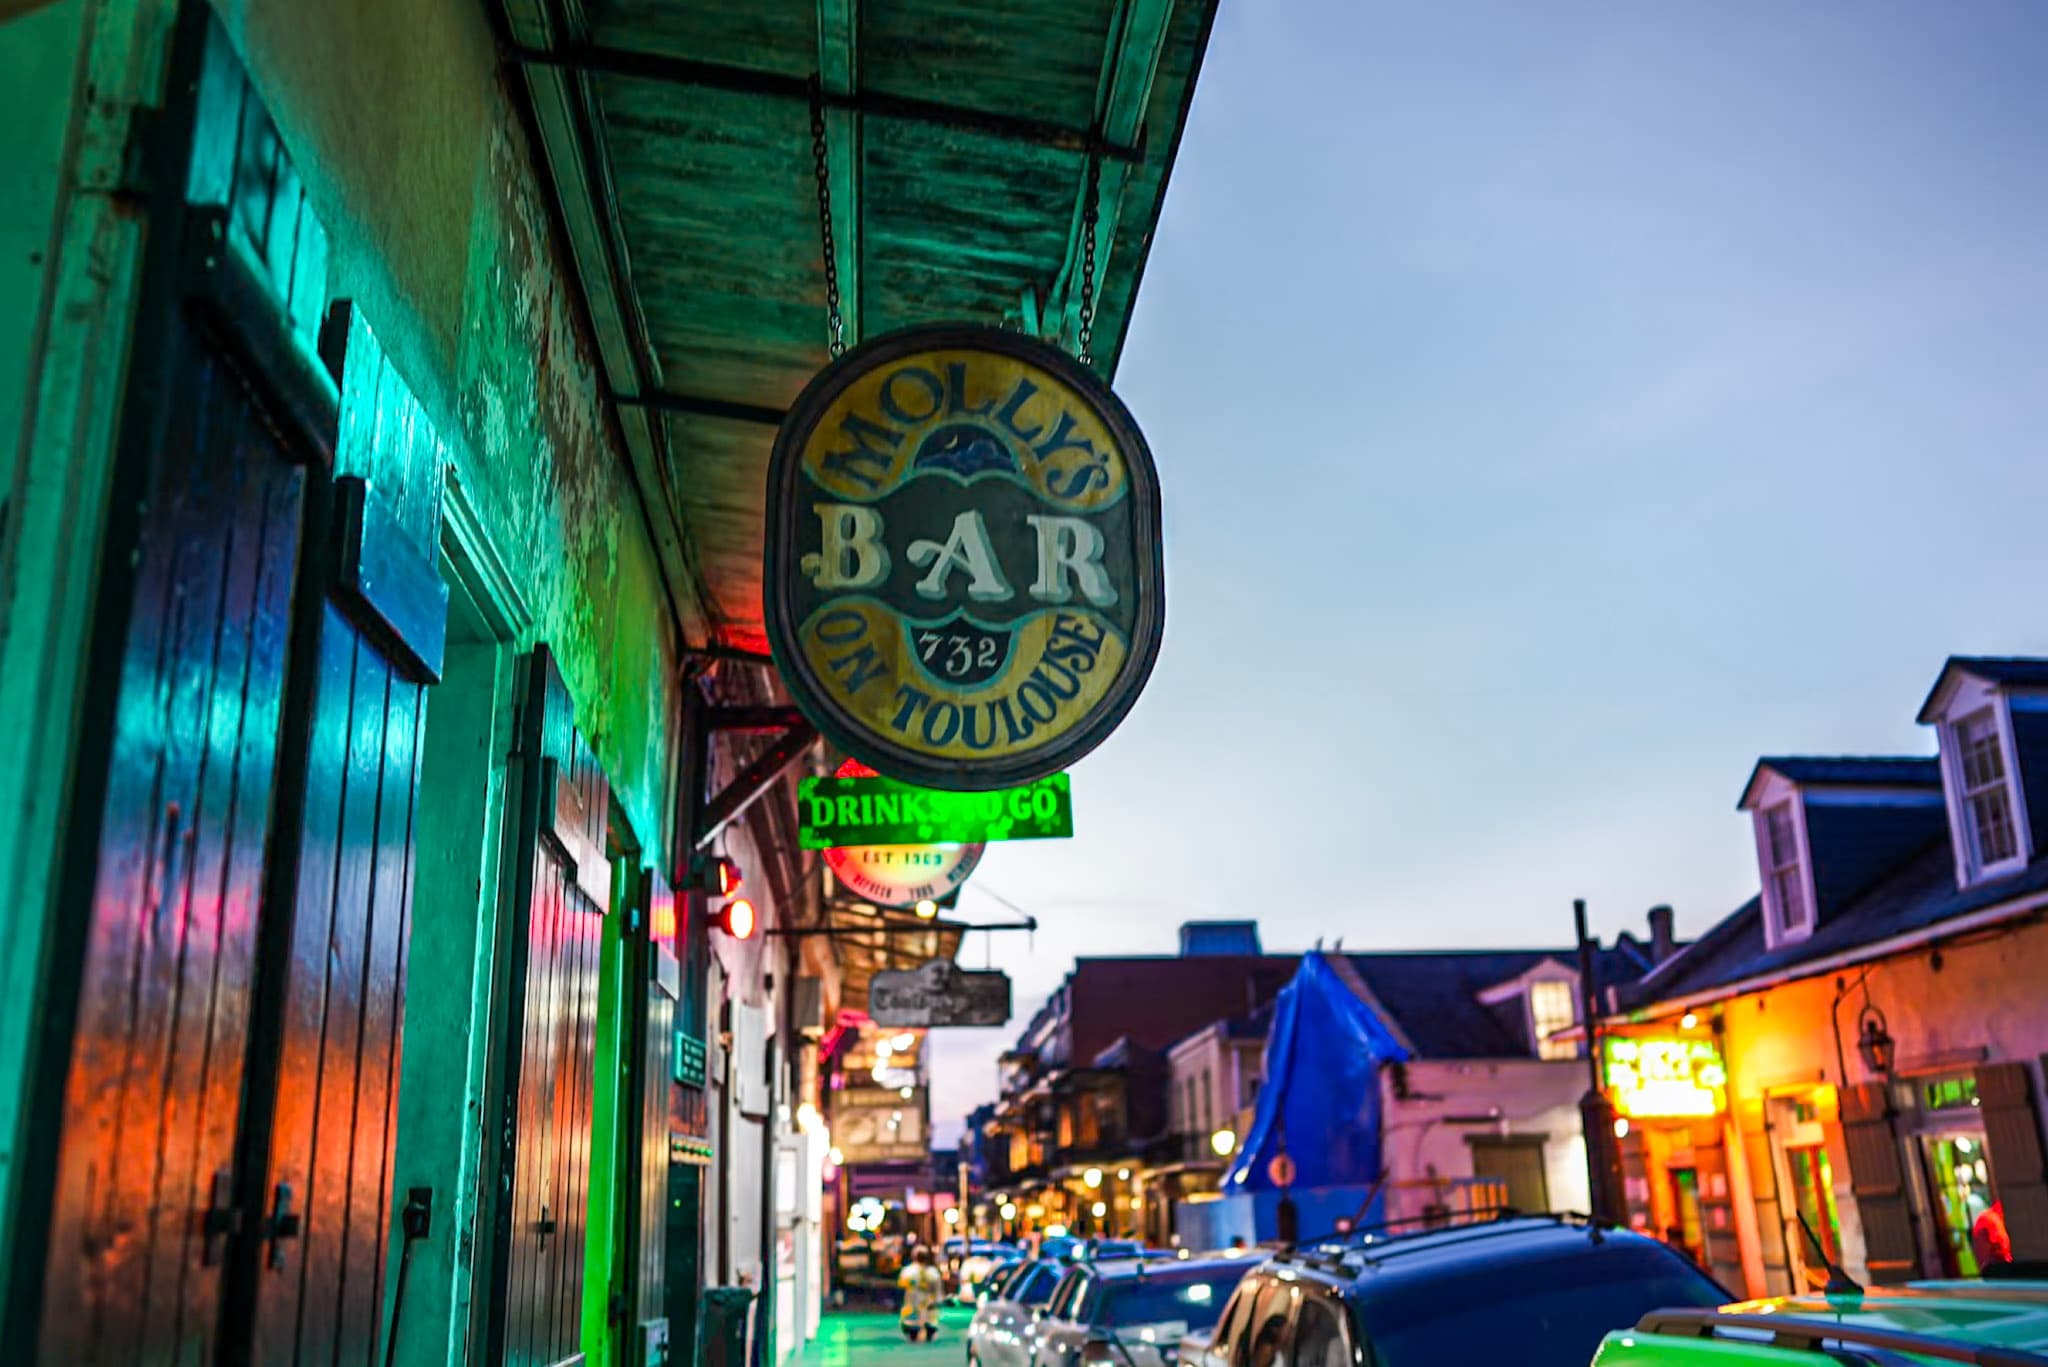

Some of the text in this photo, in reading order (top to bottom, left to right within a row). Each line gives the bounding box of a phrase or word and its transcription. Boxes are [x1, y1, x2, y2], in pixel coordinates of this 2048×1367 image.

[801, 503, 1118, 606] BAR
[816, 609, 1107, 750] ON TOULOUSE
[917, 632, 998, 678] 732
[811, 792, 950, 828] DRINKS
[1009, 787, 1056, 820] GO
